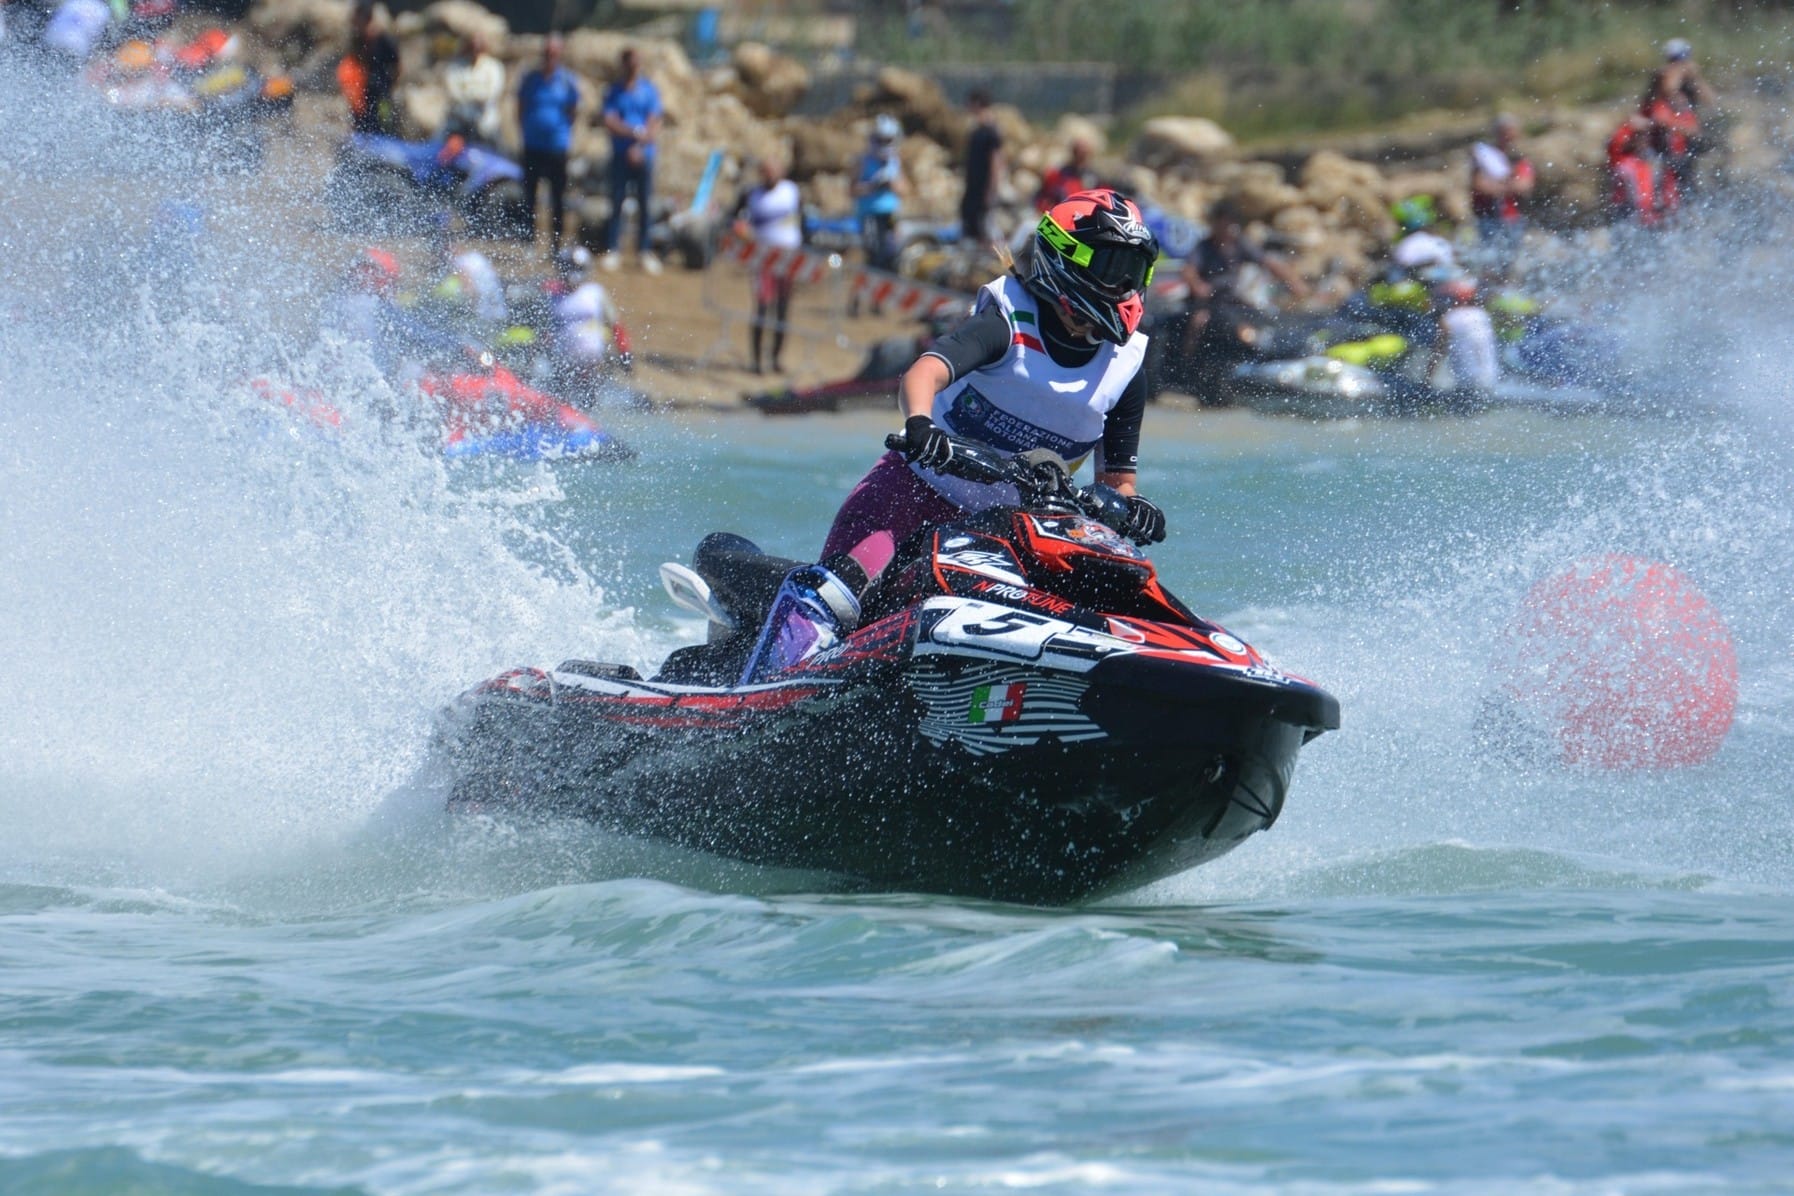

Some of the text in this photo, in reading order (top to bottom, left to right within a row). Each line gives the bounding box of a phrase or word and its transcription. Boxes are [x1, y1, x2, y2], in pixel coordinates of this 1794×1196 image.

[988, 414, 1038, 442] ITALIANA
[993, 409, 1074, 449] FEDERAZIONE
[962, 611, 1051, 636] 5
